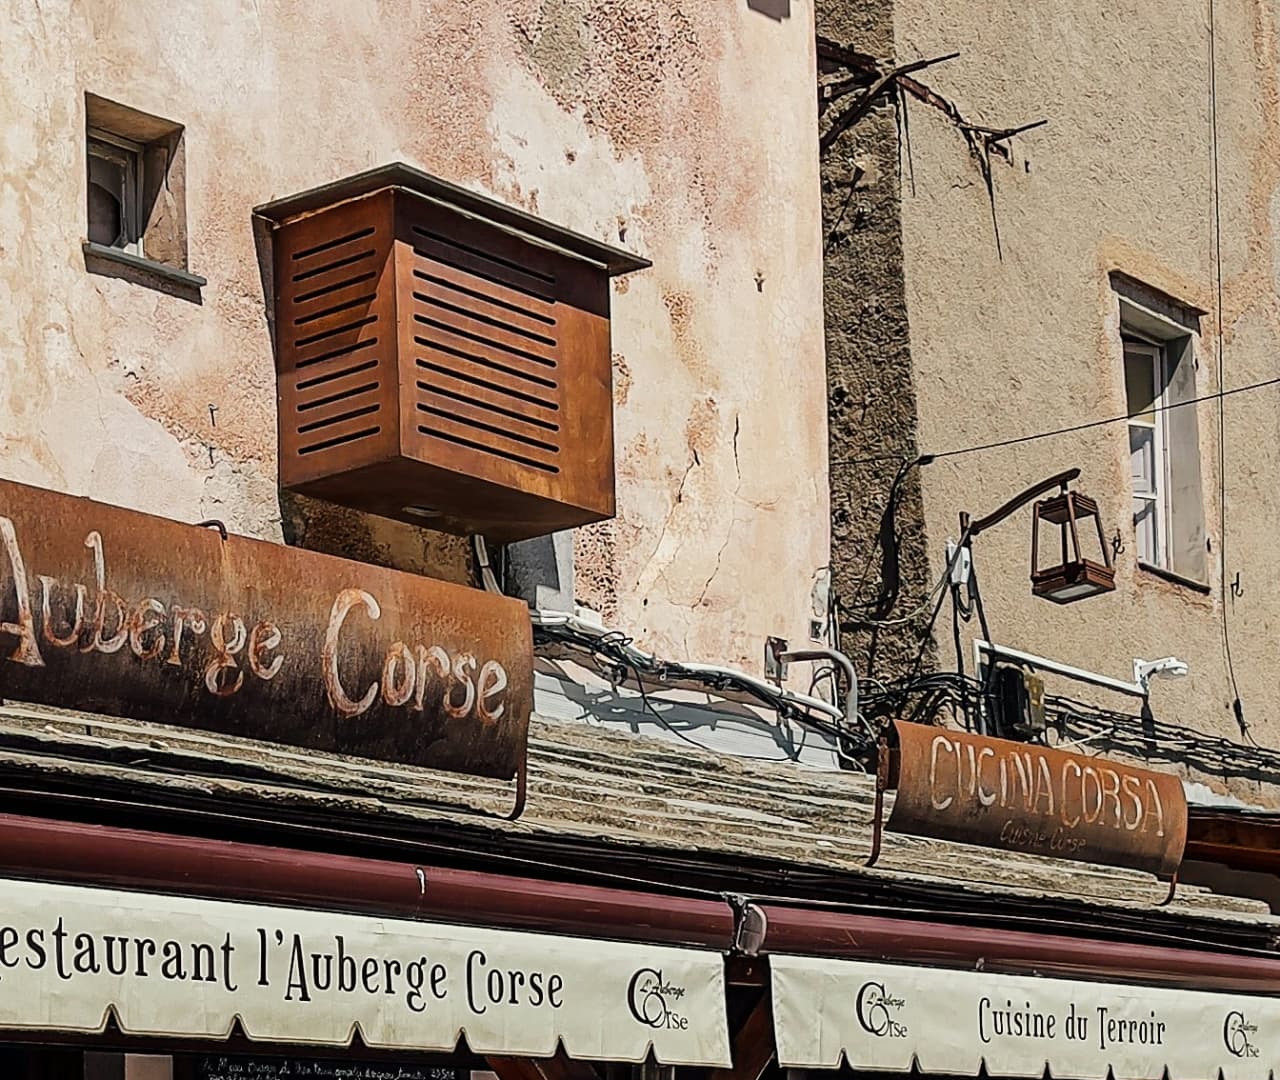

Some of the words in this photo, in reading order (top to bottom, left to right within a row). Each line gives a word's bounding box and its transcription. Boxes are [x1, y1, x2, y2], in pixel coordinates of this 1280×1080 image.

[324, 588, 507, 722] Corse
[930, 736, 1054, 814] CUCINA
[1061, 759, 1164, 837] CORSA
[257, 928, 448, 1012] l'Auberge
[466, 950, 564, 1014] Corse
[979, 997, 1056, 1043] Cuisine
[1065, 1003, 1088, 1041] du
[1097, 1007, 1166, 1049] Terroir
